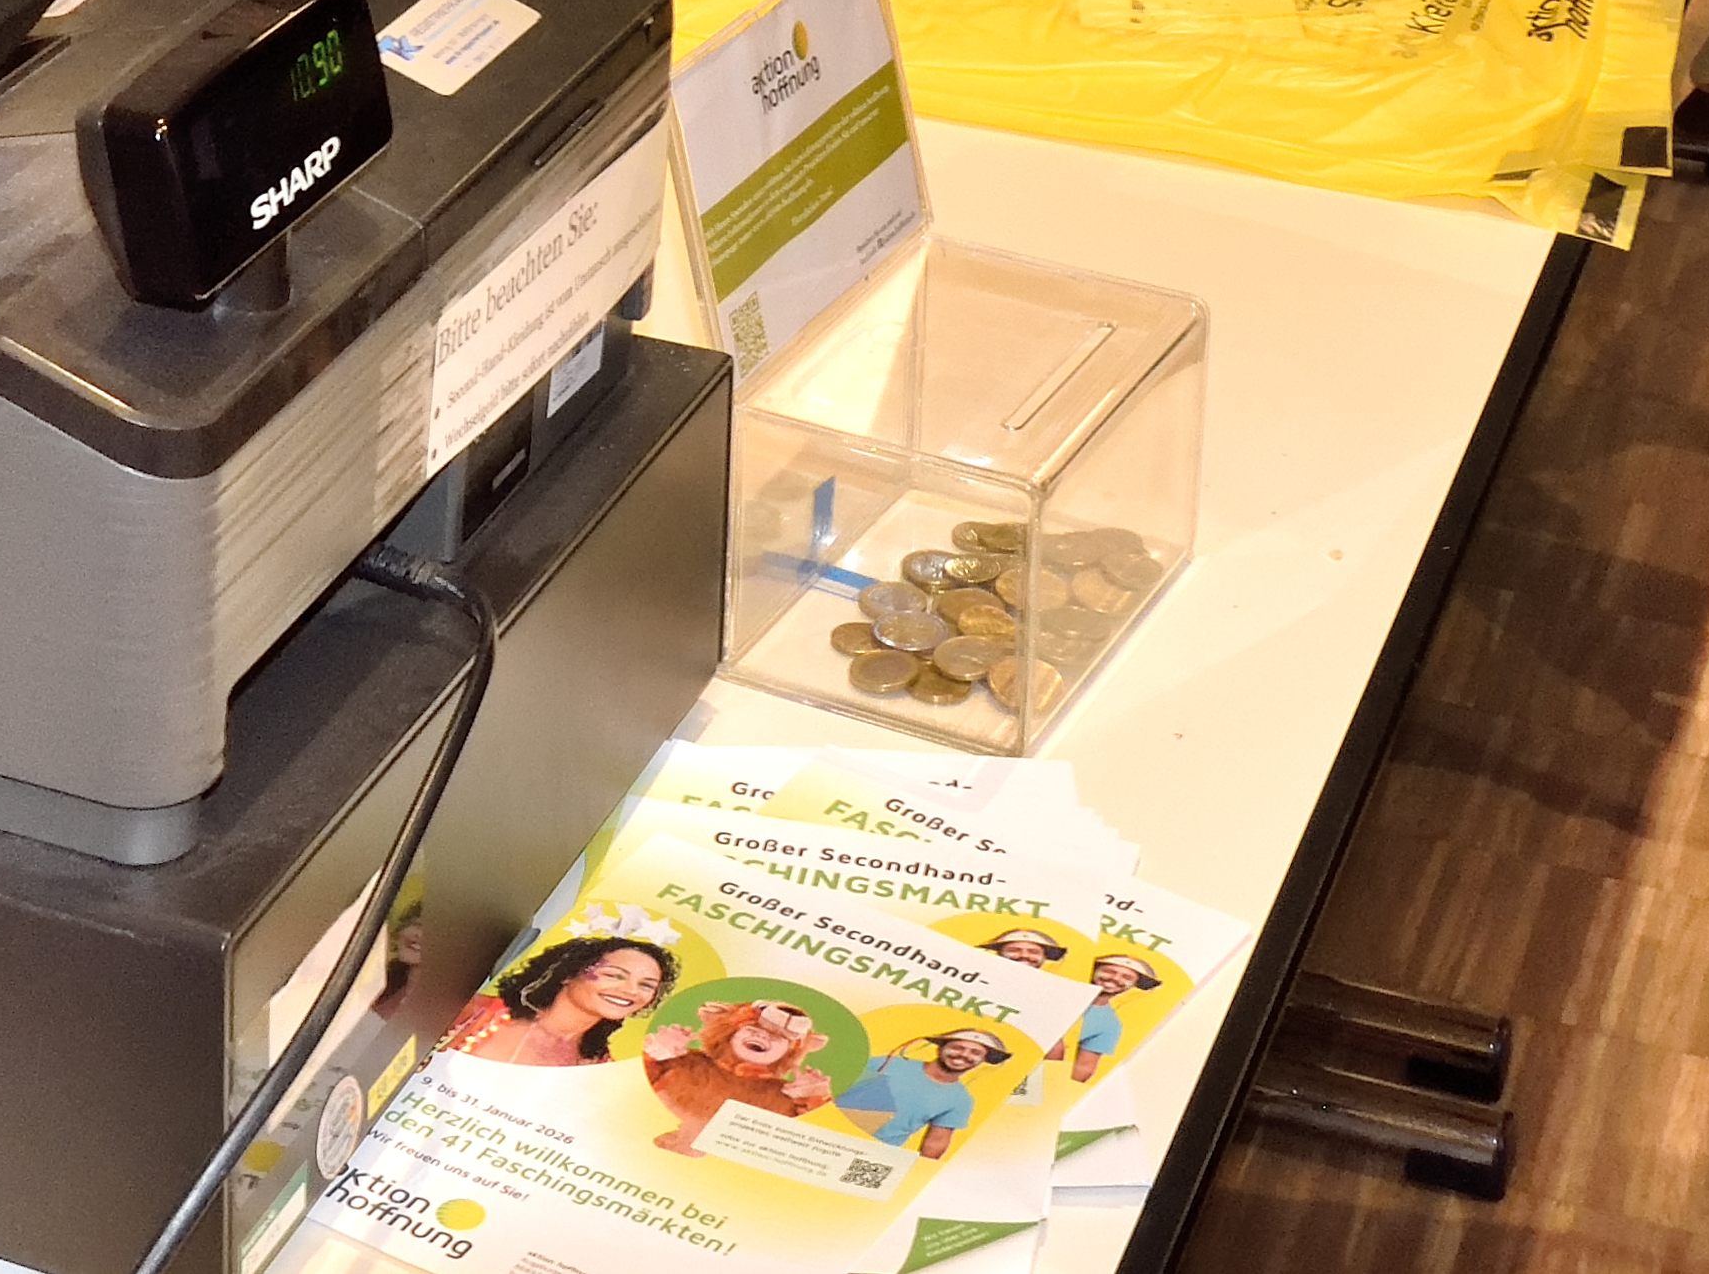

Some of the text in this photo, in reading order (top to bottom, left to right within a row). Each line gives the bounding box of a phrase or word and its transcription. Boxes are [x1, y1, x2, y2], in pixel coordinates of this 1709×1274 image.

[751, 49, 796, 96] aktion
[760, 55, 821, 115] hoffnung
[250, 136, 341, 231] SHARP
[437, 201, 599, 368] Bitte beachten Sie:
[714, 831, 1007, 887] Großer Secondhand-
[884, 797, 970, 843] Großer
[655, 882, 1021, 1025] FASCHINGSMARKT
[718, 880, 991, 988] Großer Secondhand-
[437, 1083, 459, 1100] bis
[459, 1095, 481, 1114] 31.
[481, 1103, 532, 1130] Januar
[535, 1123, 576, 1146] 2026
[384, 1108, 738, 1257] den 41 Faschingsmärkten!
[394, 1139, 441, 1167] freuen
[443, 1160, 470, 1181] uns
[472, 1171, 498, 1191] auf
[498, 1181, 531, 1203] Sie!
[399, 1091, 509, 1145] Herzlich
[514, 1137, 676, 1212] willkommen
[681, 1202, 729, 1230] bei
[325, 1182, 473, 1261] hoffnung
